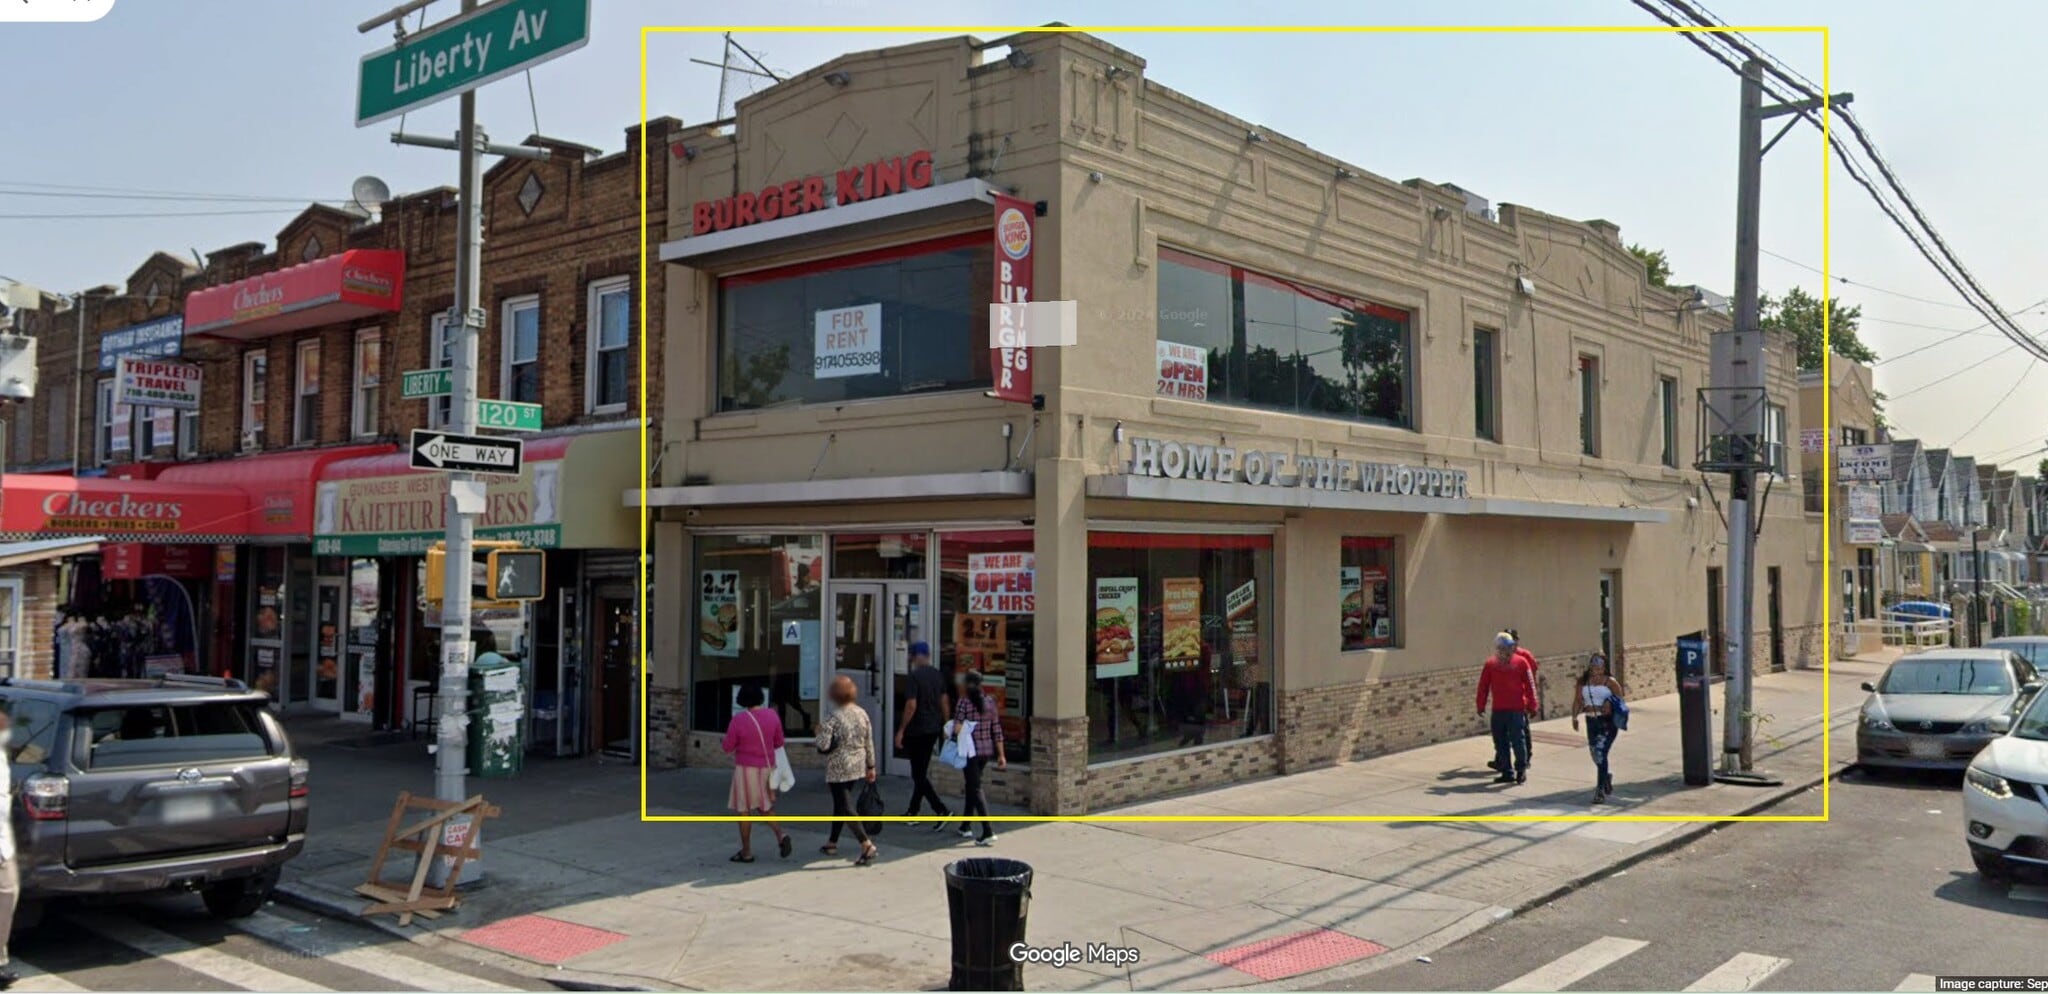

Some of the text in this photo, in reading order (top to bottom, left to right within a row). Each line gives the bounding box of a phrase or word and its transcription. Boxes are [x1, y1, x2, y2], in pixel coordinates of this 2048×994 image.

[393, 8, 548, 94] Liberty Av
[693, 149, 933, 236] BURGER KING
[1004, 230, 1027, 243] KING
[832, 310, 864, 330] FOR
[999, 261, 1016, 389] BURGER
[1015, 286, 1028, 371] KING
[826, 327, 868, 350] RENT
[815, 351, 881, 370] 9174055398
[1168, 344, 1197, 361] WE ARE
[1160, 360, 1204, 383] OPEN
[136, 376, 186, 392] TRAVEL
[403, 373, 441, 396] LIBERTY
[1157, 380, 1206, 400] 24 HRS
[480, 404, 536, 426] 120 ST
[429, 443, 508, 463] ONE WAY
[1132, 437, 1472, 499] HOME OF THE WHOPPER
[1840, 460, 1889, 468] INCOME
[1853, 467, 1876, 475] TAX
[350, 481, 399, 497] GUYANESE
[407, 479, 434, 494] WEST
[42, 492, 182, 518] Checkers
[341, 491, 529, 532] KAIETEUR ERESS
[51, 520, 176, 530] BURGERS FRIES COLAS
[984, 555, 1023, 569] WE ARE
[703, 573, 714, 594] 2
[720, 573, 738, 594] $7
[974, 572, 1033, 593] OPEN
[971, 595, 1035, 612] 24 HRS
[785, 625, 798, 639] A
[1687, 651, 1697, 665] P
